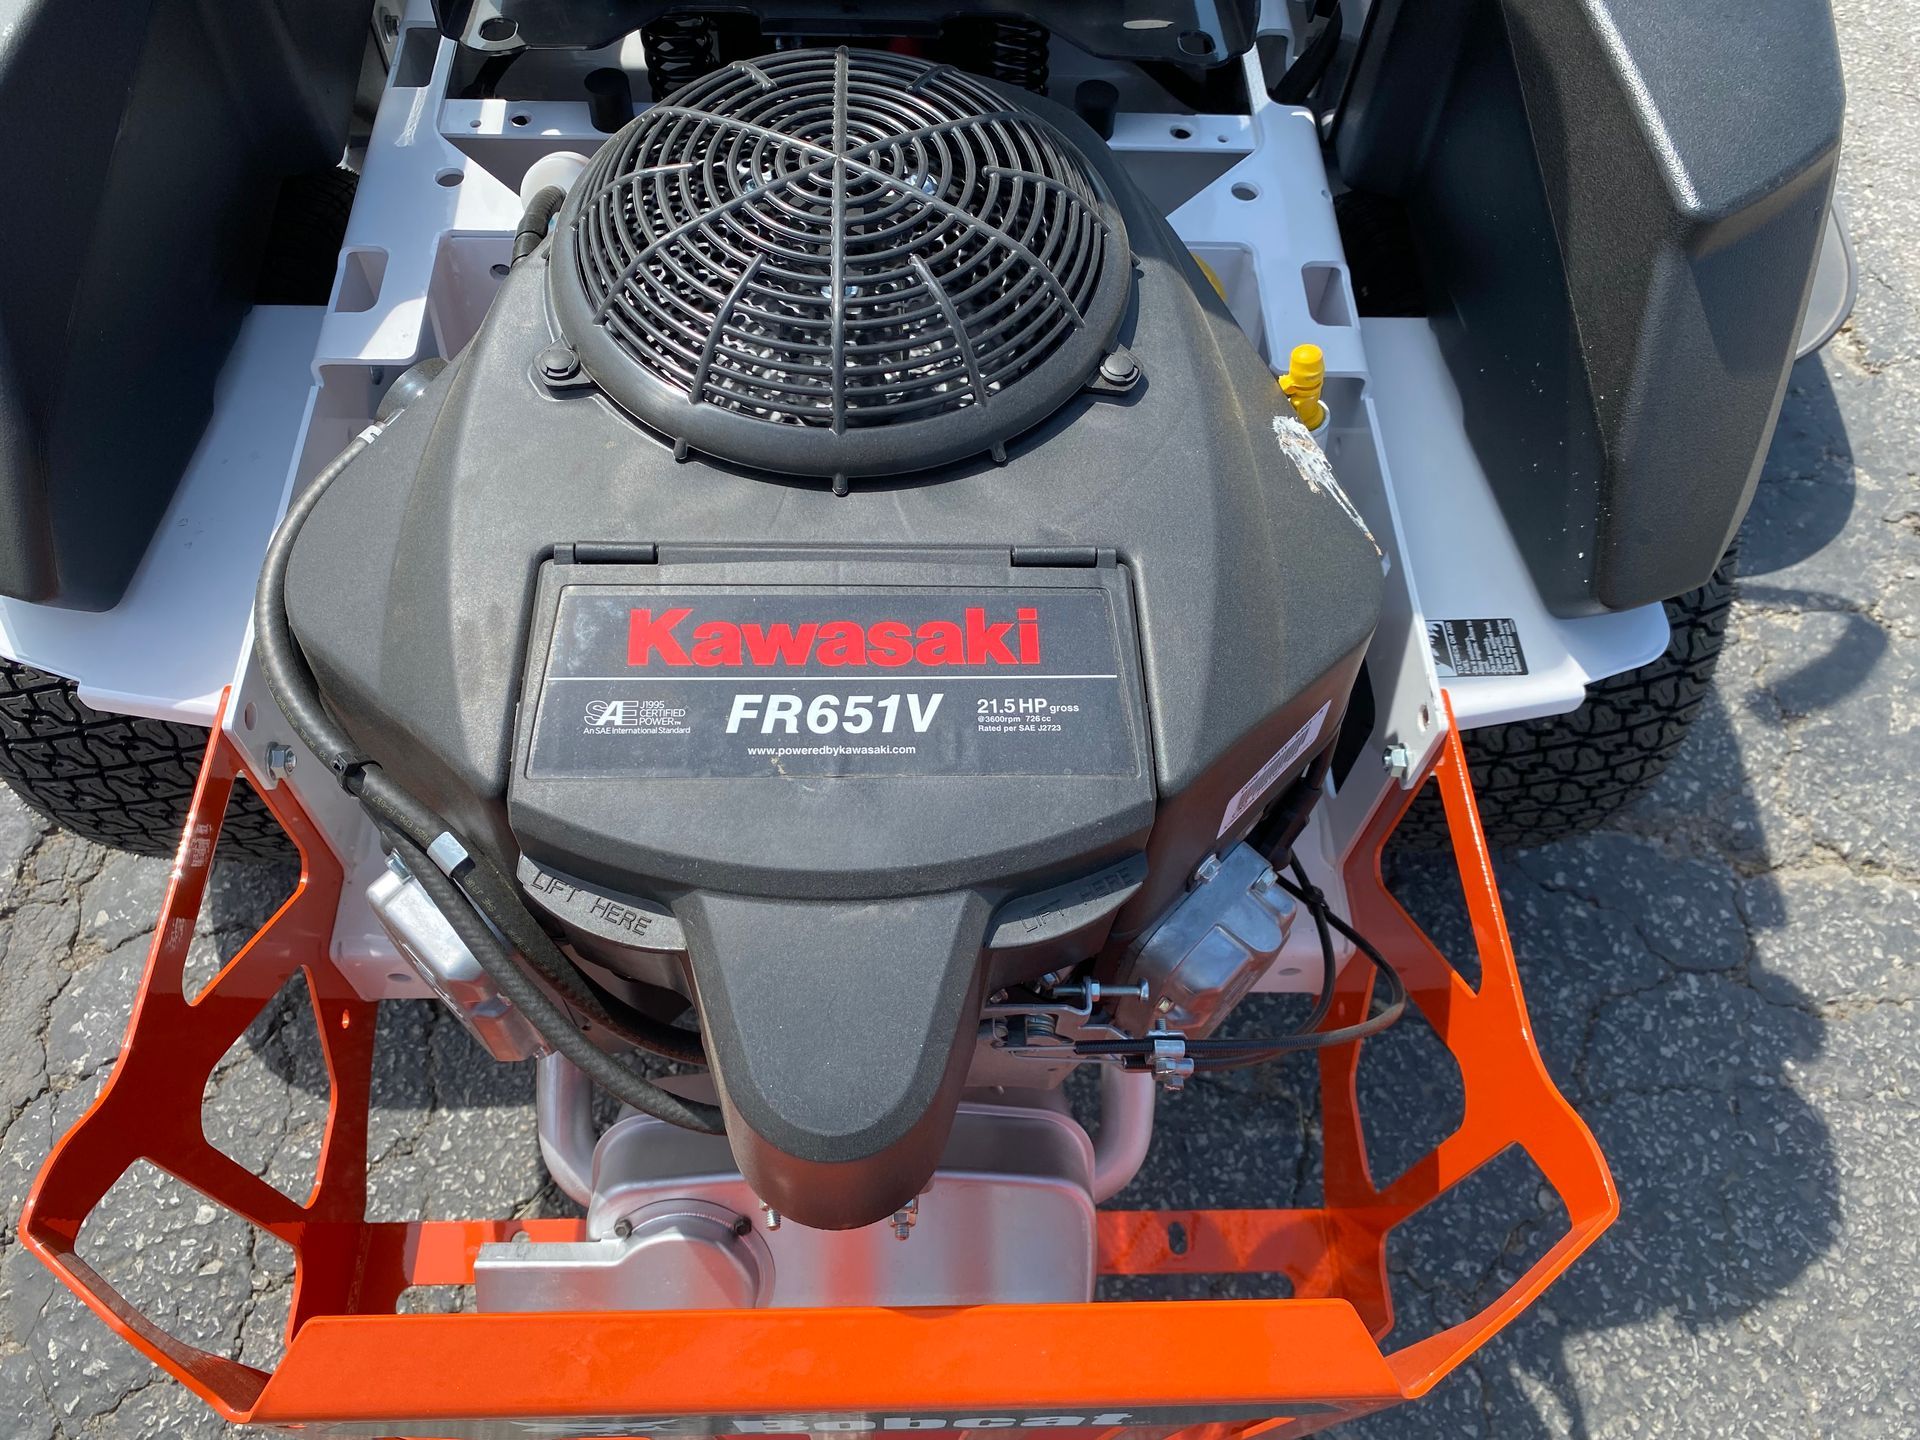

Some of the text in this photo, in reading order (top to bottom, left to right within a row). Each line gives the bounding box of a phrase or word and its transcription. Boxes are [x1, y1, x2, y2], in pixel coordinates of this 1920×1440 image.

[627, 607, 1041, 668] Kawasaki
[583, 699, 639, 726] SAE
[639, 700, 666, 709] J1995
[976, 698, 1080, 714] 21.5 HP gross
[639, 708, 686, 718] CERTIFIED
[724, 693, 945, 735] FR651V
[977, 715, 1021, 724] @3600rpm
[1025, 715, 1041, 723] 726
[582, 726, 691, 735] An SAE International Standard
[1003, 725, 1017, 733] per
[1018, 724, 1036, 732] SAE
[1037, 724, 1062, 732] J2723
[747, 744, 916, 757] www.poweredbykawasaki.com
[531, 870, 652, 936] LIFT HERE
[1018, 898, 1065, 933] LIFT
[732, 1412, 1134, 1433] Bobcat
